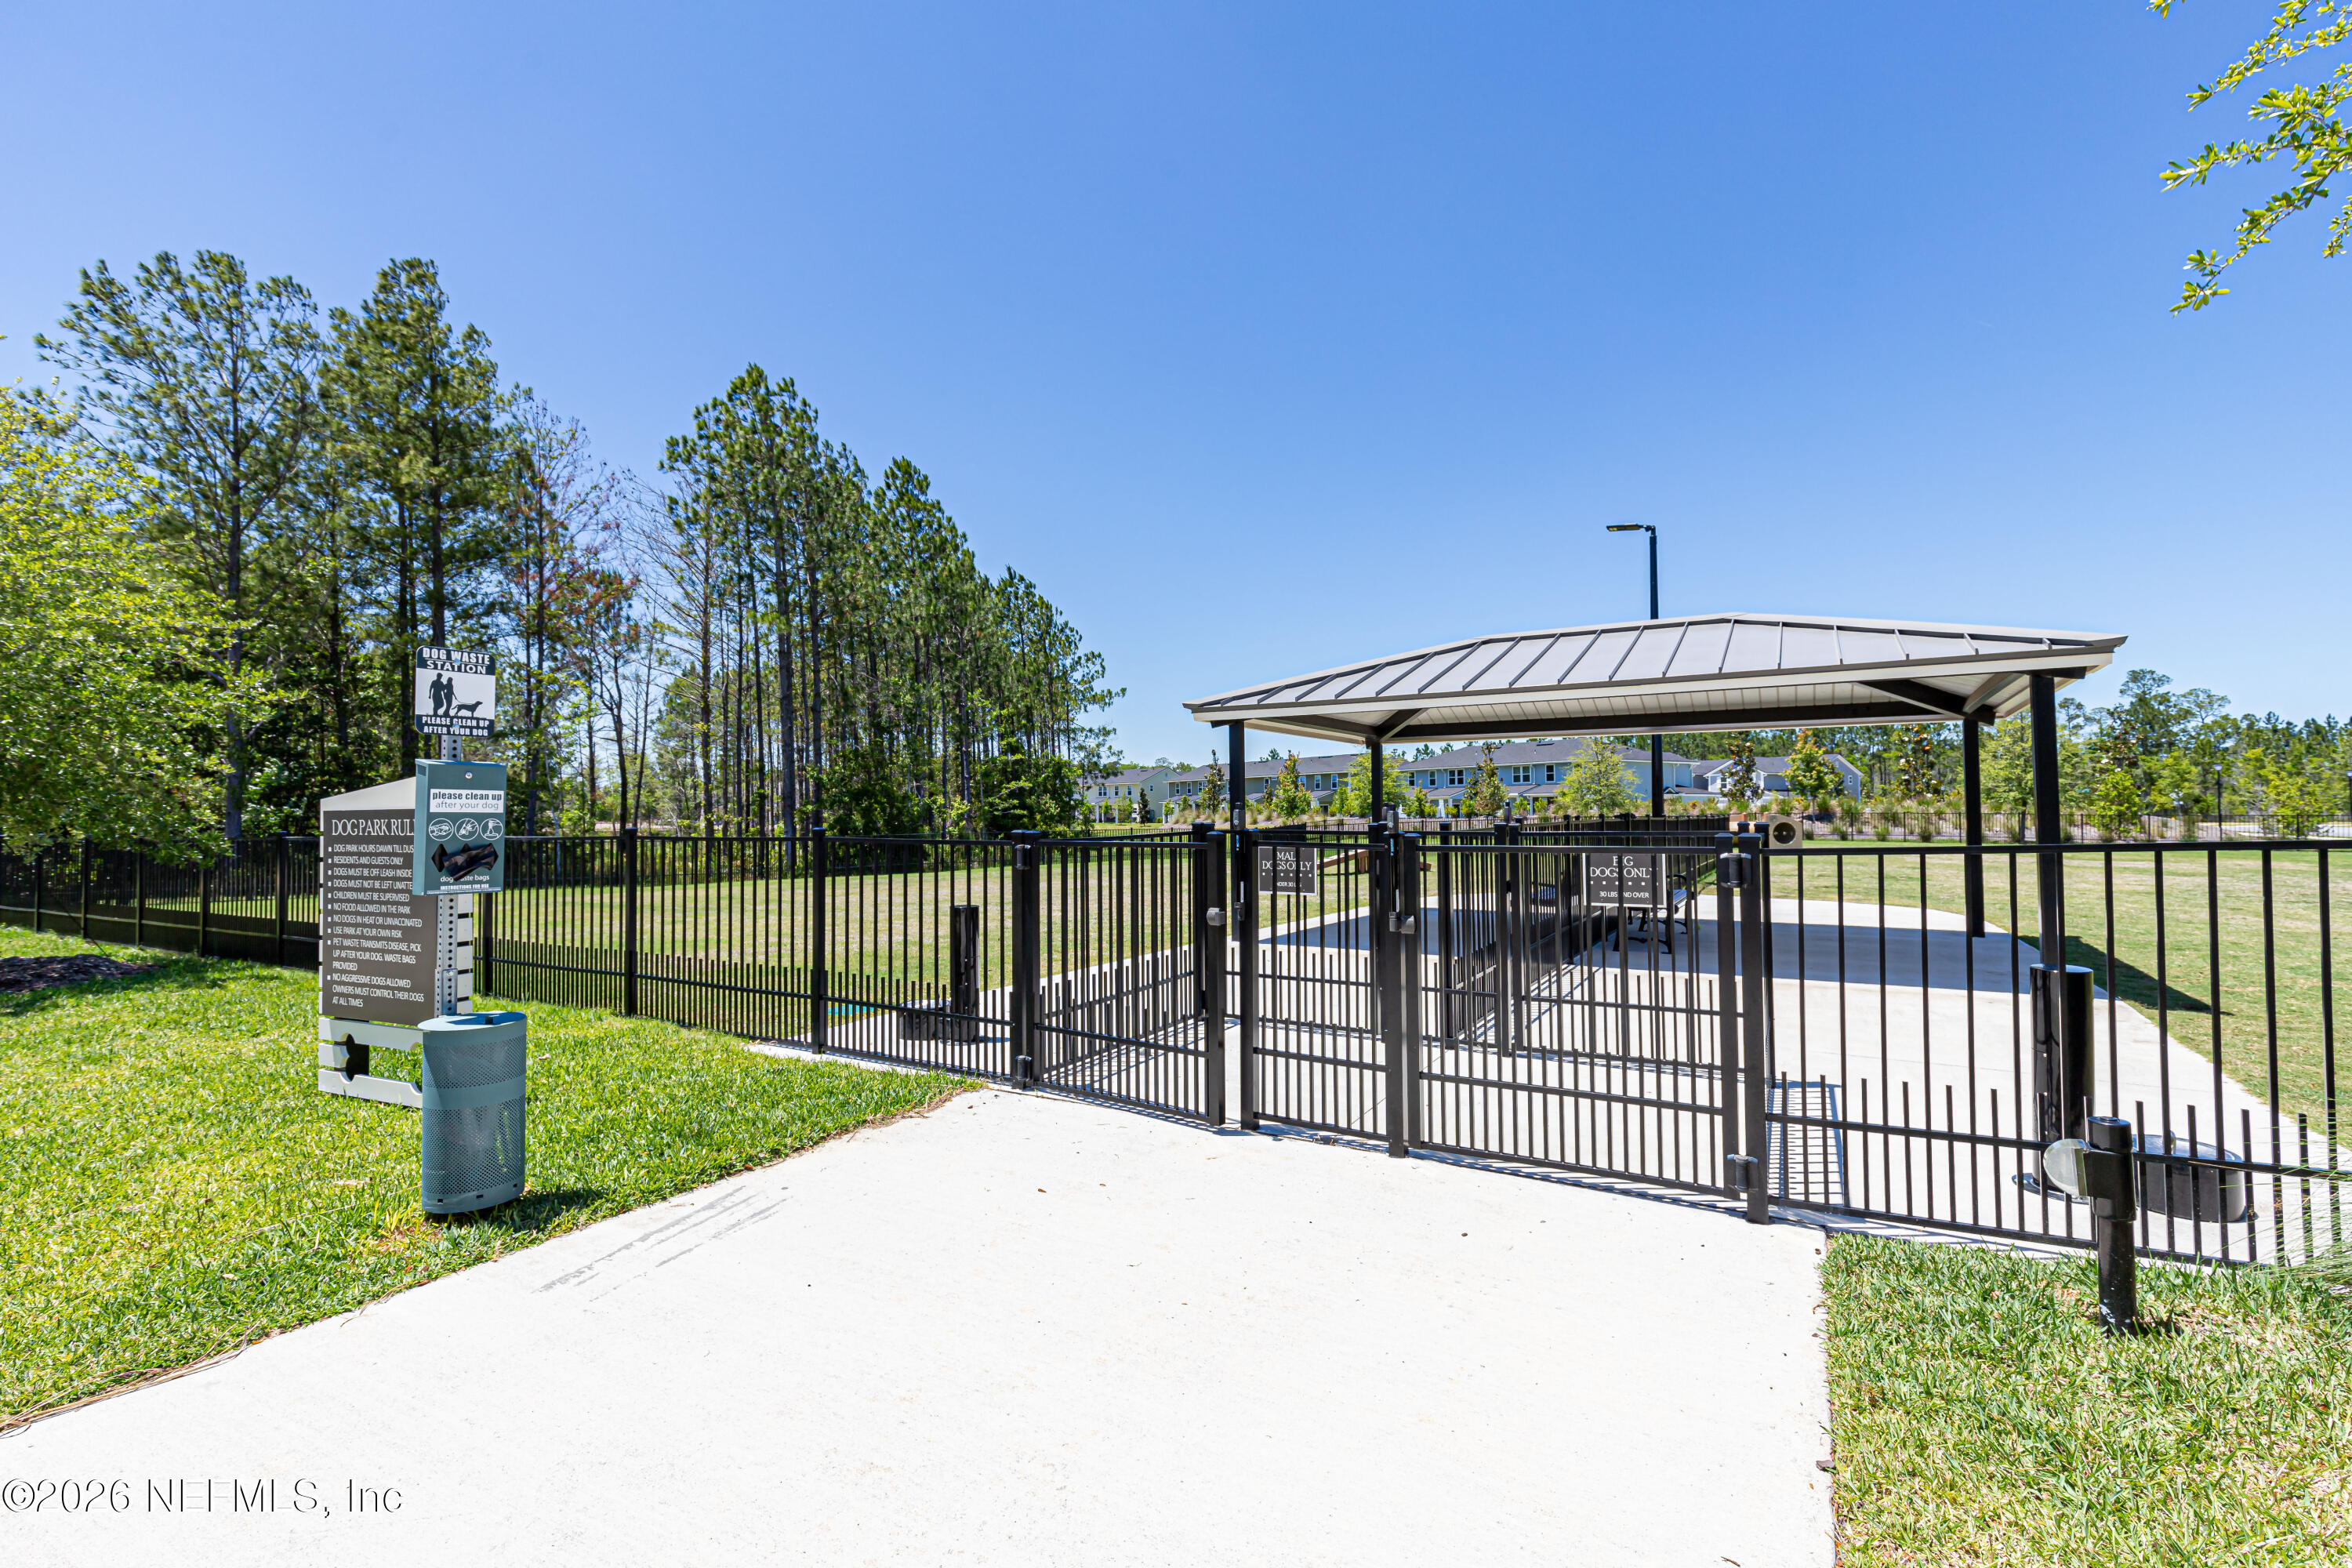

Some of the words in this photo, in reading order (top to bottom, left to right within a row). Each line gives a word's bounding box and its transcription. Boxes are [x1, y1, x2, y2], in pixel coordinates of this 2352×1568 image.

[423, 648, 447, 659] DOG
[451, 651, 490, 665] WASTE
[426, 660, 486, 674] STATION
[422, 717, 451, 725] PLEASE
[453, 718, 477, 727] CLEAN
[450, 727, 470, 735] YOUR
[433, 792, 463, 800] please
[465, 792, 489, 800] clean
[436, 800, 456, 809] after
[481, 801, 499, 811] dog
[332, 819, 358, 836] DOG
[359, 819, 389, 836] PARK
[390, 818, 416, 836] RUL
[334, 844, 345, 852] DOG
[358, 844, 376, 853] HOURS
[403, 844, 414, 853] DUS
[372, 856, 390, 865] GUESTS
[390, 857, 403, 866] ONLY
[1276, 851, 1296, 860] MAL
[1613, 856, 1634, 866] BG
[1287, 861, 1312, 870] OLY
[334, 867, 348, 876] DOGS
[397, 869, 412, 878] INSIDE
[1624, 867, 1658, 878] ONL
[364, 880, 374, 888] NOT
[393, 881, 412, 890] UNATTE
[333, 891, 358, 899] CHILDREN
[379, 893, 409, 902] SUPERVISED
[357, 904, 381, 913] ALLOWED
[387, 905, 397, 913] THE
[397, 906, 411, 914] PARK
[333, 914, 342, 923] NO
[362, 916, 376, 924] HEAT
[384, 917, 422, 927] UNVACCINATED
[333, 926, 343, 935] USE
[377, 928, 390, 938] OWN
[343, 938, 359, 947] WASTE
[361, 939, 388, 949] TRANSMITS
[389, 941, 409, 952] DISEASE,
[409, 943, 422, 952] PICK
[340, 950, 356, 959] AFTER
[384, 953, 401, 963] WASTE
[401, 955, 416, 964] BAGS
[332, 961, 358, 971] PROVIDED
[340, 974, 371, 984] AGGRESSIVE
[372, 977, 386, 985] DOGS
[386, 978, 411, 988] ALLOWED
[332, 985, 354, 994] OWNERS
[354, 986, 369, 996] MUST
[370, 988, 394, 999] CONTROL
[394, 991, 409, 1000] THEIR
[409, 993, 424, 1002] DOGS
[332, 996, 339, 1004] AT
[348, 997, 364, 1007] TIMES
